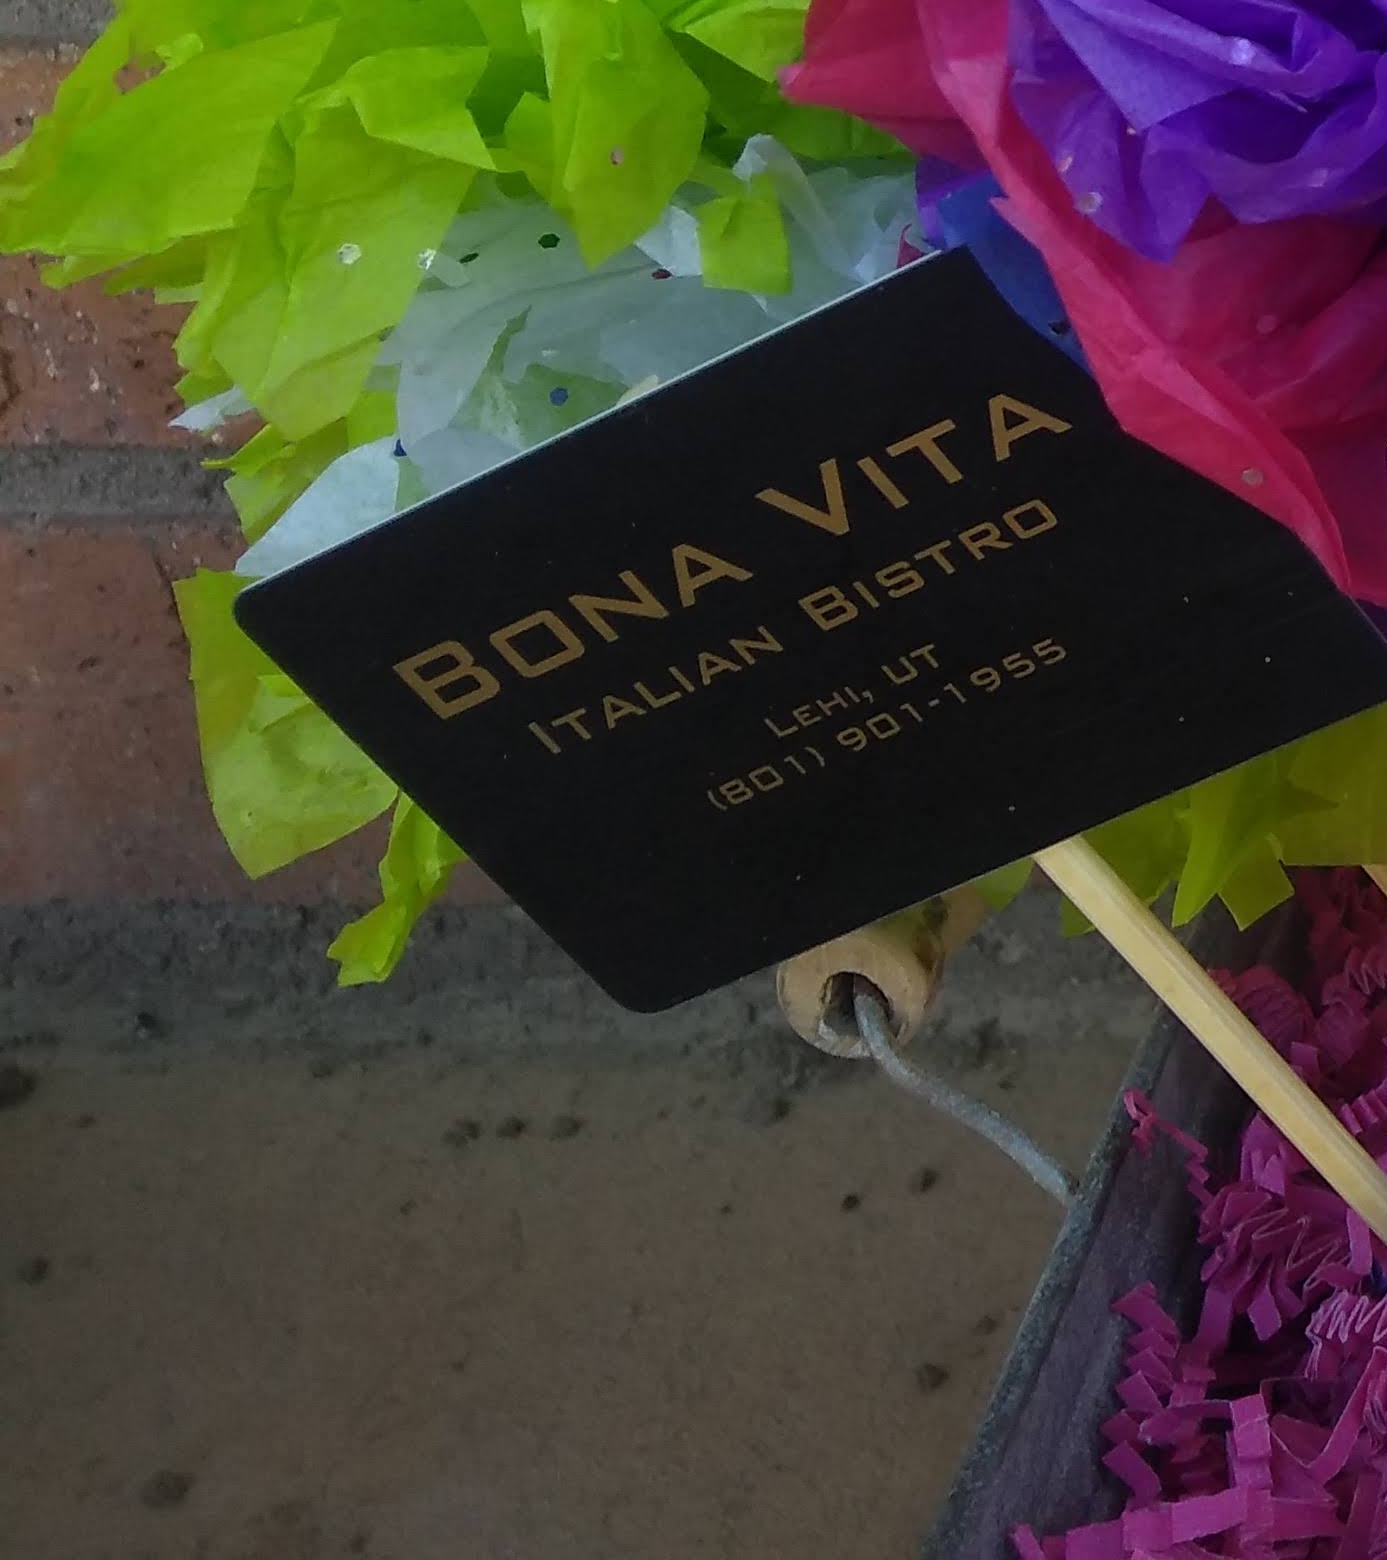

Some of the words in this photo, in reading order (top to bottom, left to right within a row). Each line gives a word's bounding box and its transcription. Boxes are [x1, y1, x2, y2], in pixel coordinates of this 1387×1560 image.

[392, 541, 755, 721] BONA
[755, 392, 1074, 537] VITA
[528, 624, 785, 755] ITALIAN
[797, 498, 1059, 633] BISTRO
[881, 643, 940, 685] UT
[707, 746, 826, 810] (801)
[837, 637, 1067, 751] 901-1955
